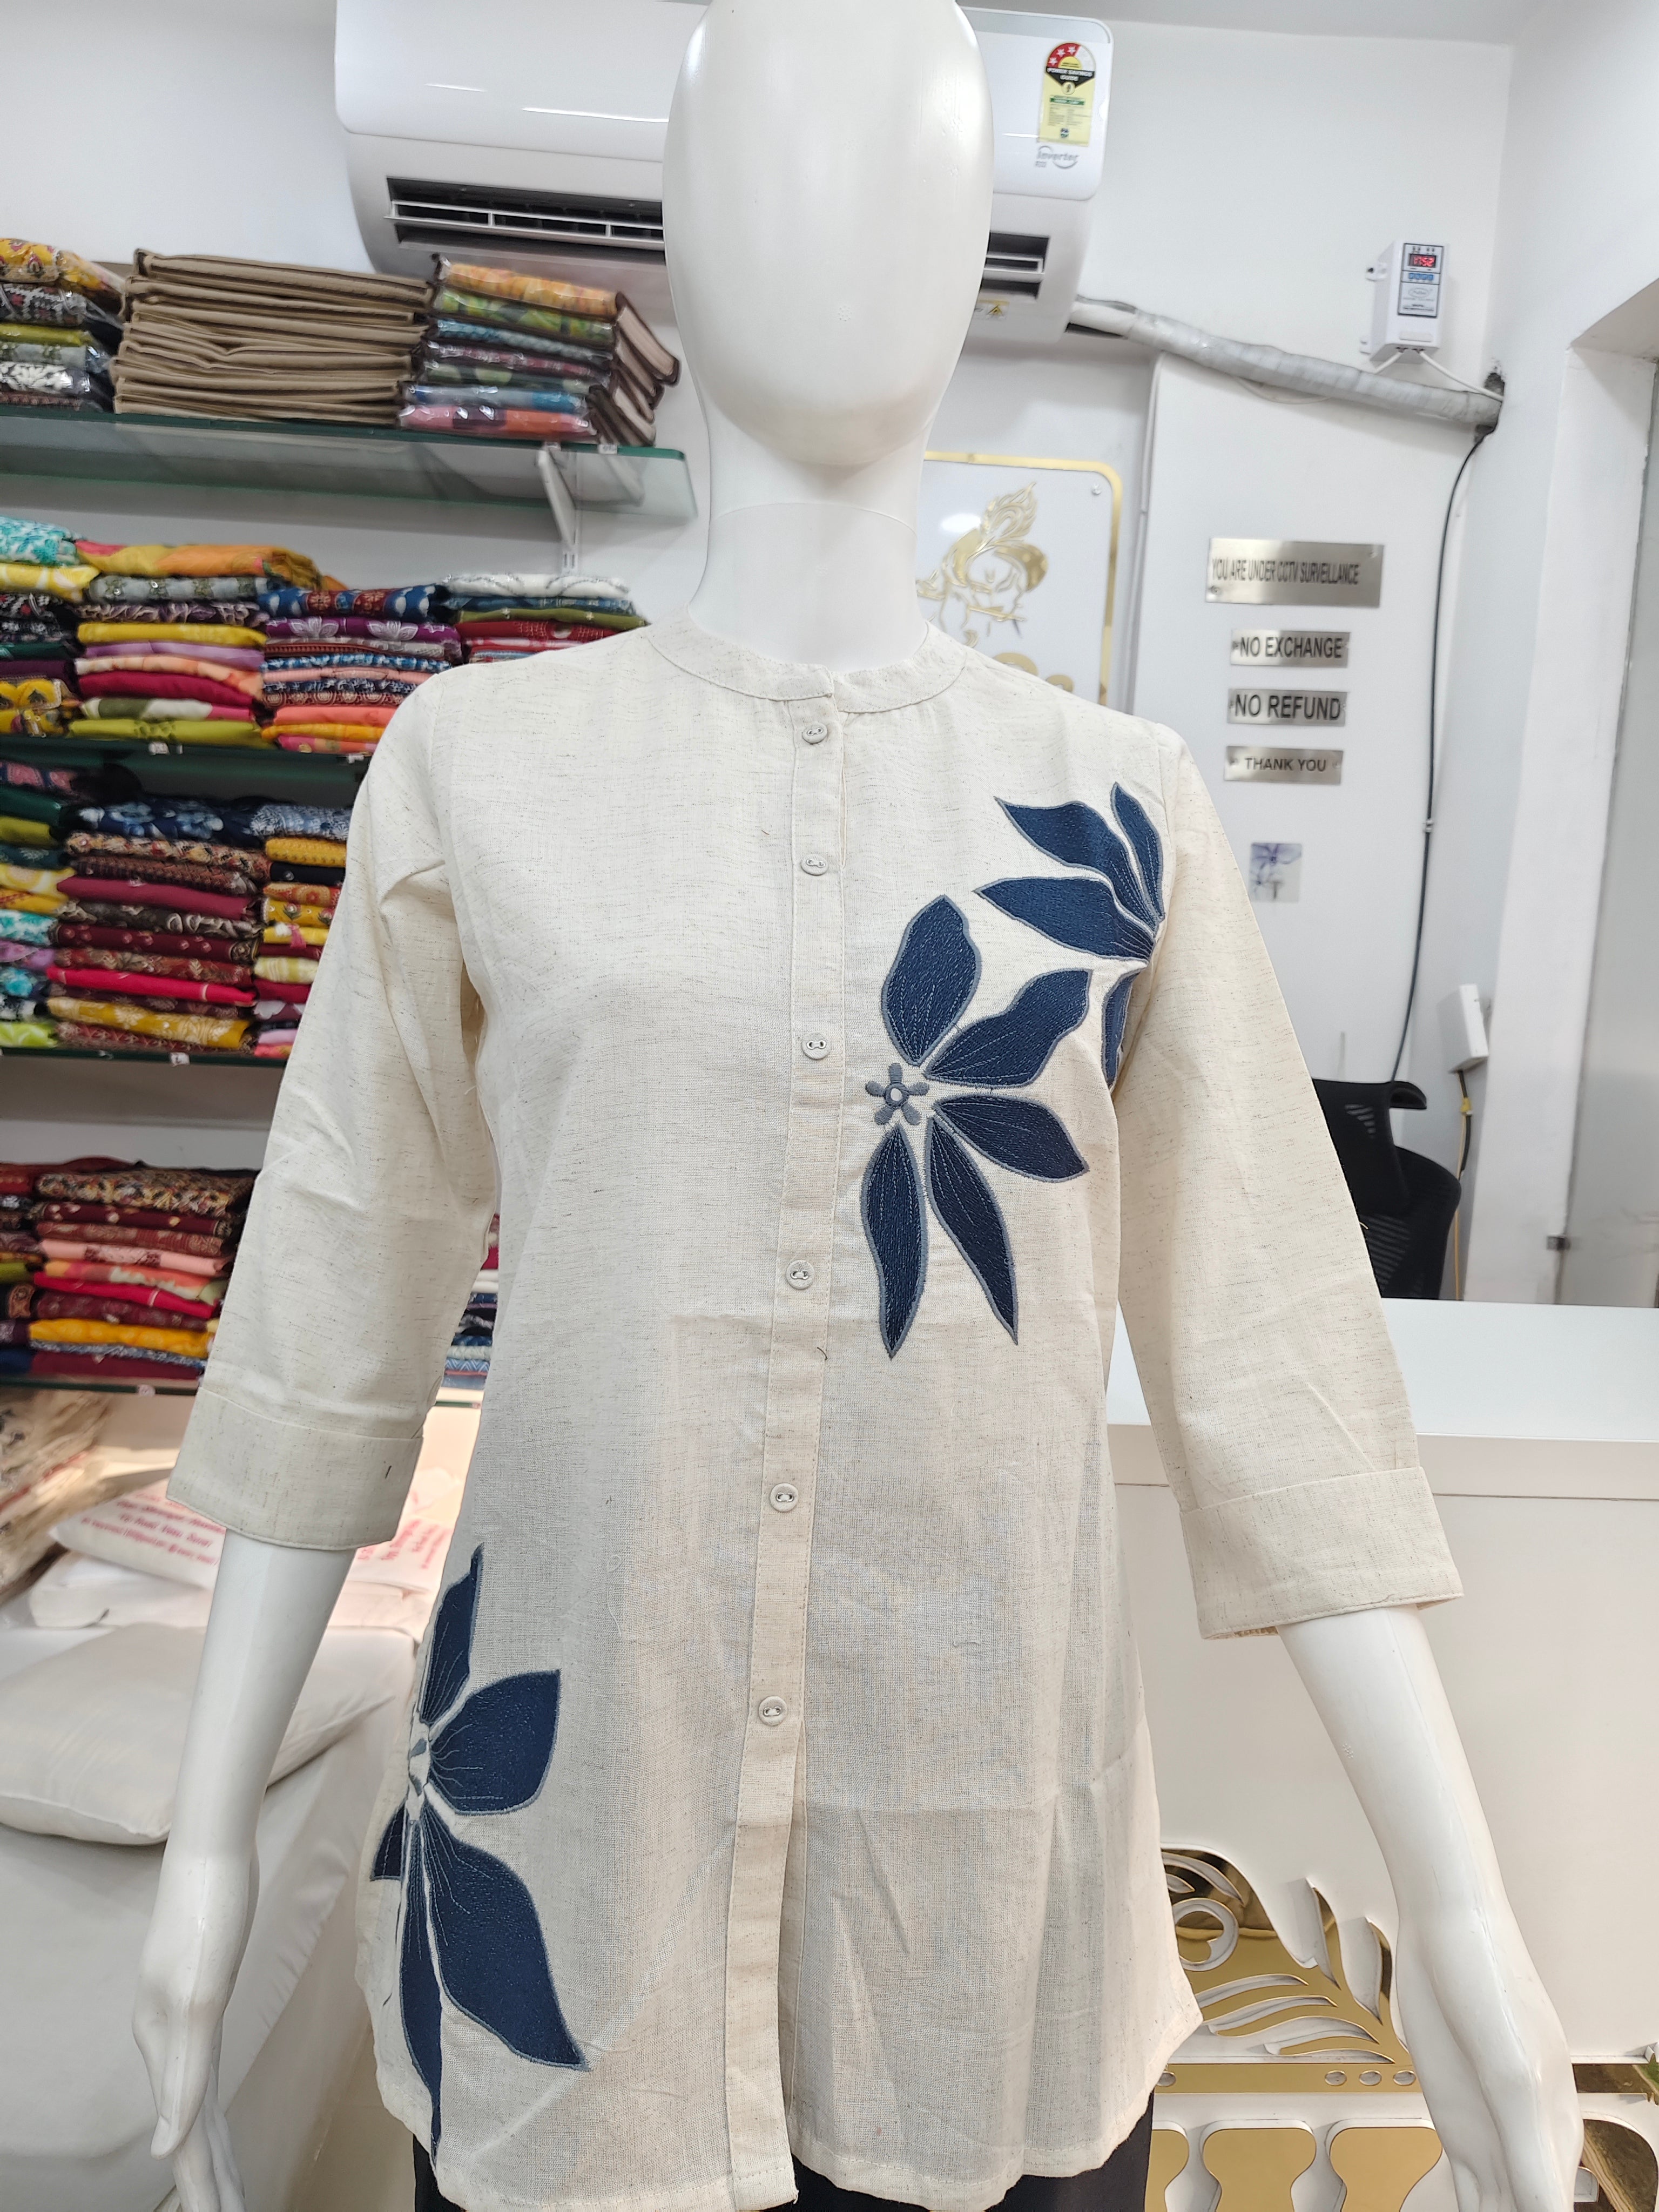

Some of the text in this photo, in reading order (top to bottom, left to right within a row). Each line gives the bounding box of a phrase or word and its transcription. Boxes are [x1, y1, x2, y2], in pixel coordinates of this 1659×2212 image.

[1212, 558, 1228, 580] YOU
[1230, 559, 1246, 581] ARE
[1248, 559, 1276, 582] UNDER
[1277, 561, 1297, 583] CCTV
[1240, 636, 1342, 658] NO EXCHANGE
[1235, 694, 1340, 720] NO REFUND
[1245, 758, 1326, 772] THANK YOU
